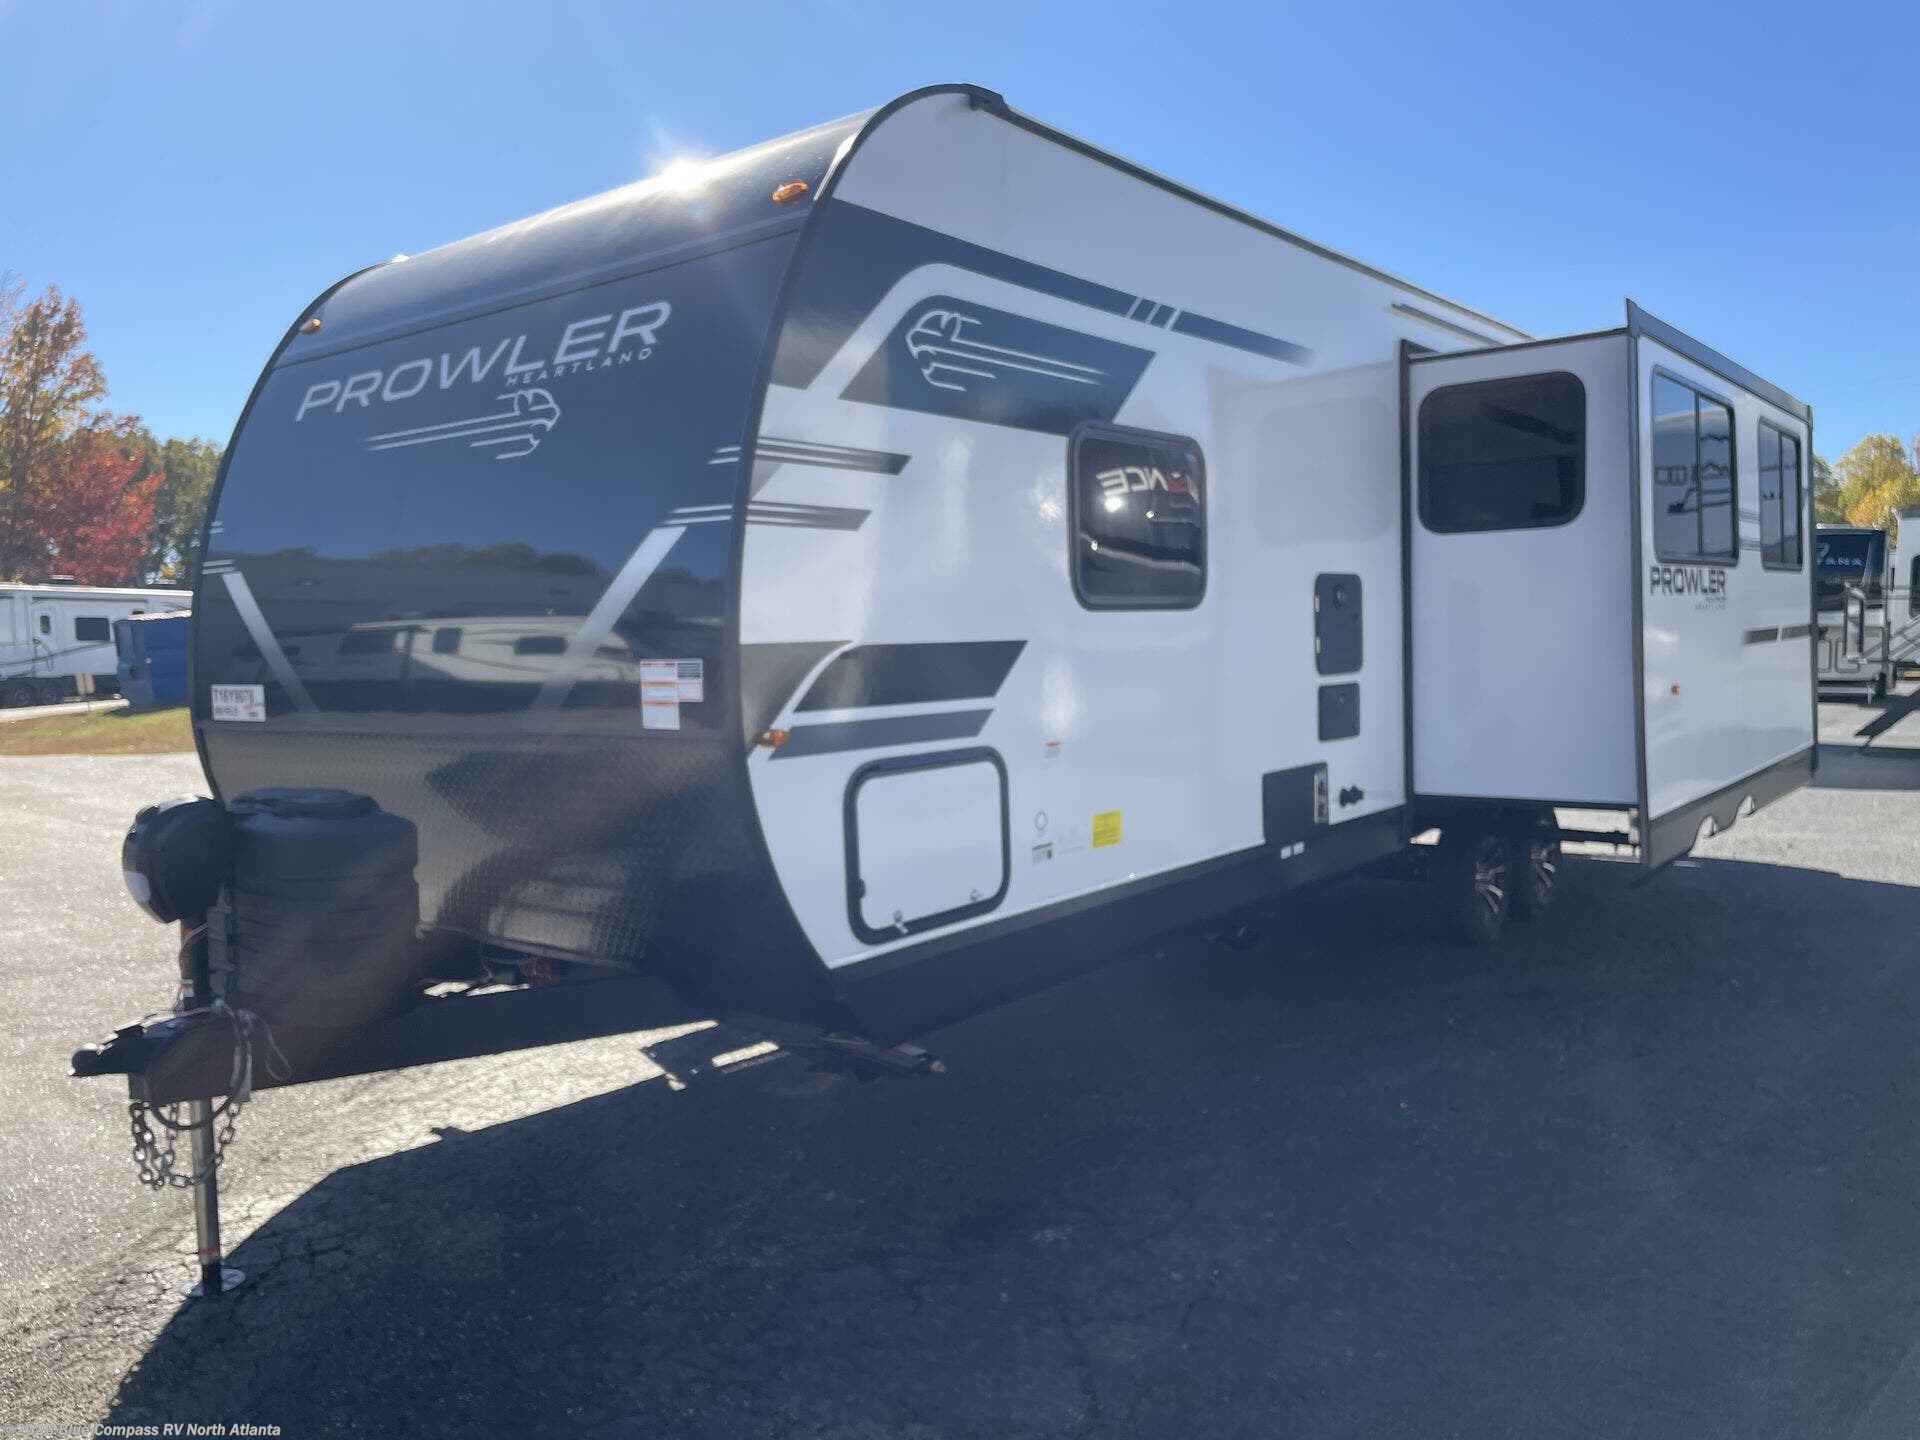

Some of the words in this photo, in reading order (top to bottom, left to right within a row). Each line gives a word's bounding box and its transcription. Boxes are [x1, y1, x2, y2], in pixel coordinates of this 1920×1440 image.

[296, 300, 672, 421] PROWLER
[506, 347, 653, 387] HEARTLAND
[1650, 567, 1726, 595] PROWLER
